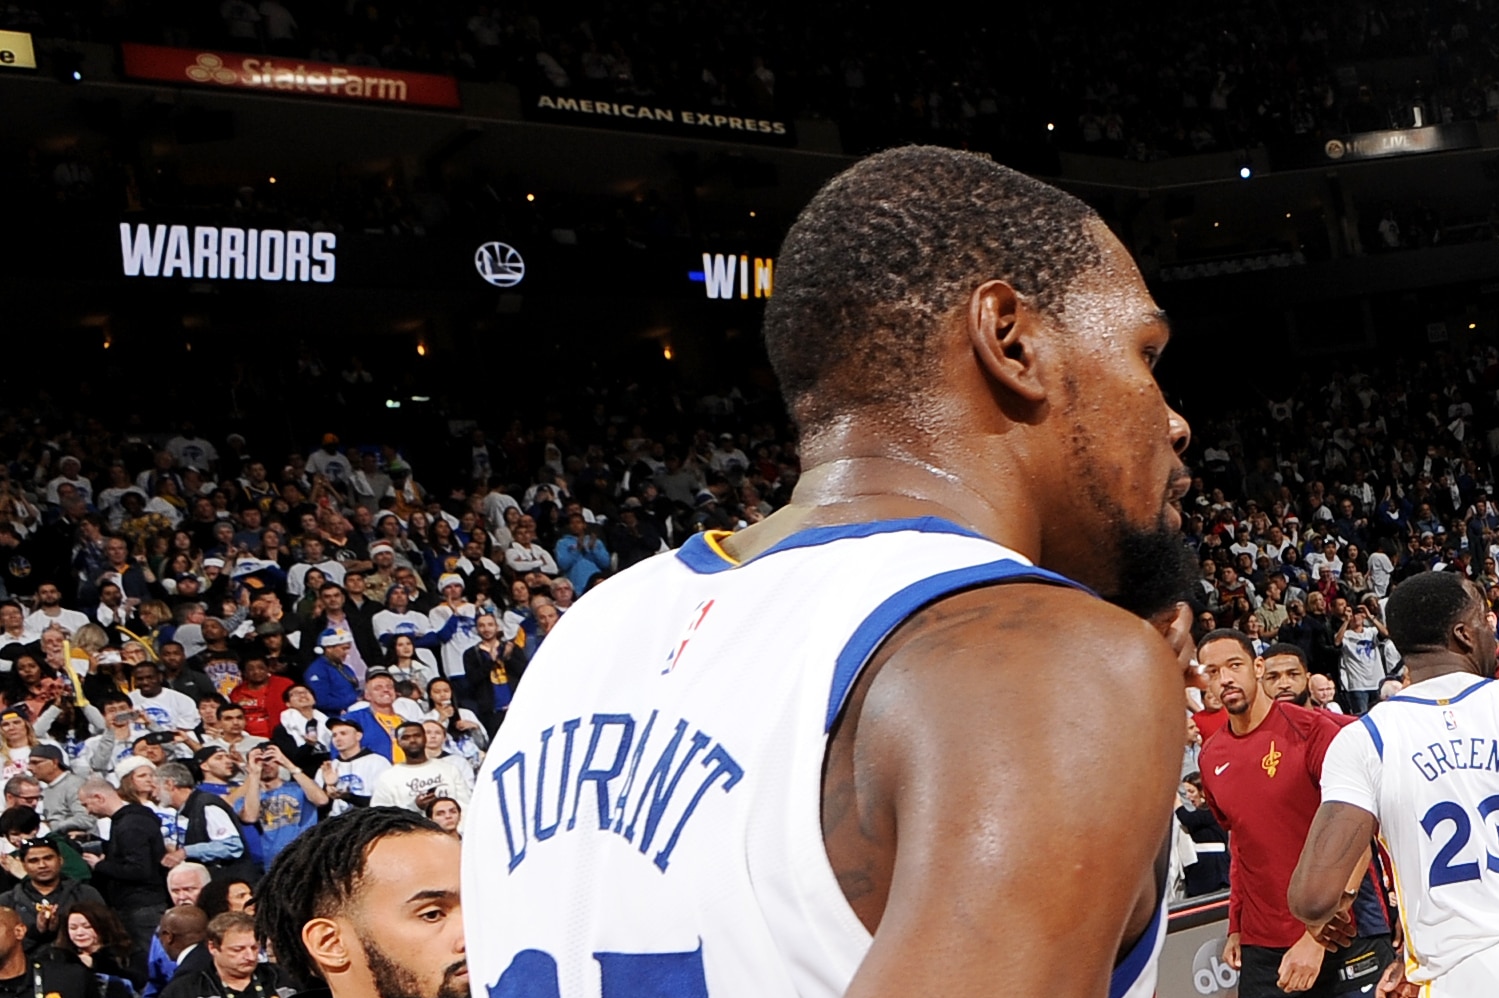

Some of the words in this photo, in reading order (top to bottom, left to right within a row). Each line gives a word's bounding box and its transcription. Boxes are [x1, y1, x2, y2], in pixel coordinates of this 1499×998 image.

[537, 95, 674, 122] AMERICAN
[681, 111, 787, 135] EXPRESS
[119, 222, 337, 283] WARRIORS
[492, 709, 746, 874] DURANT
[1194, 955, 1240, 995] ab
